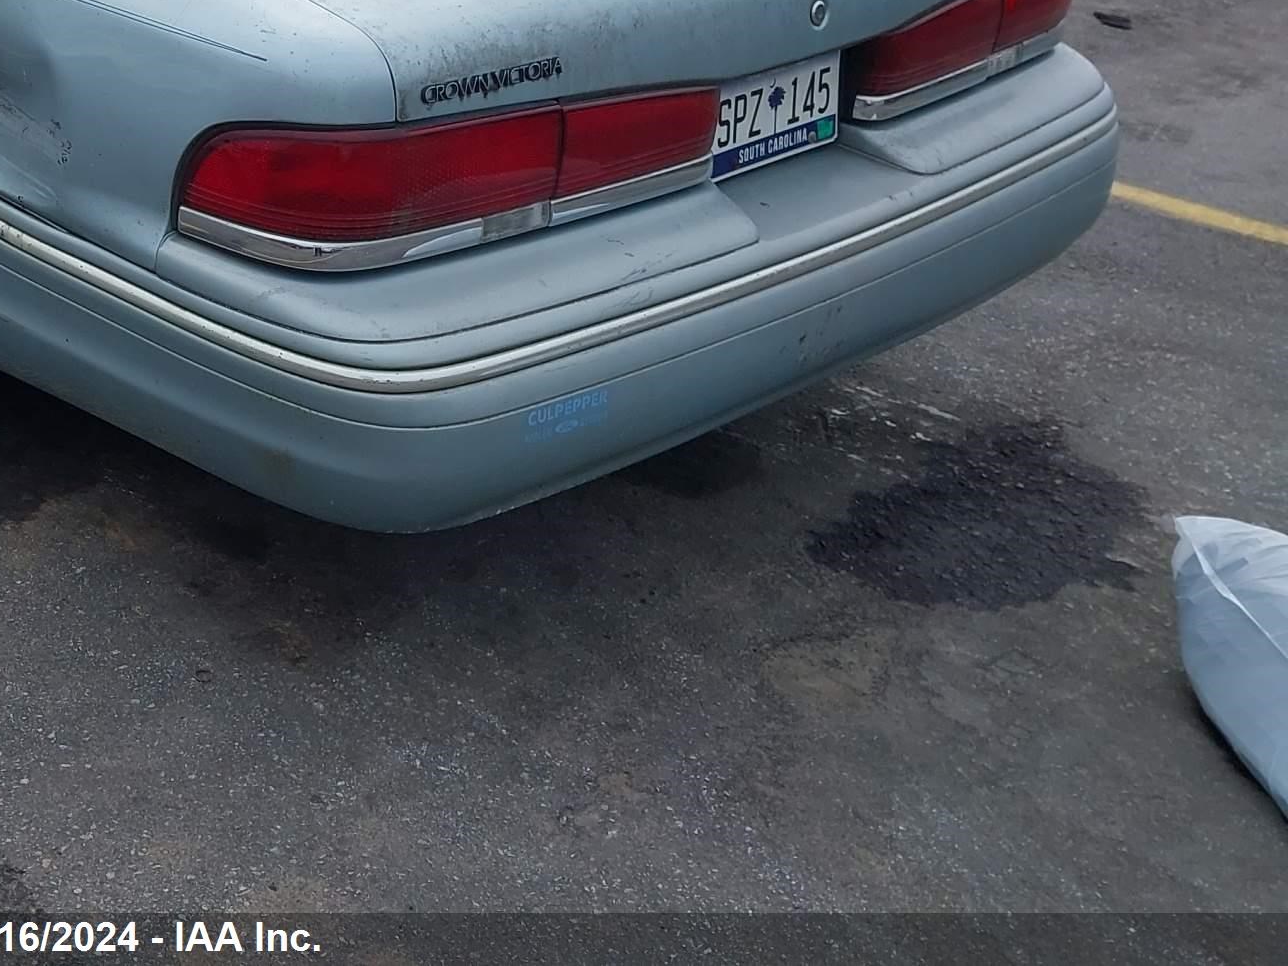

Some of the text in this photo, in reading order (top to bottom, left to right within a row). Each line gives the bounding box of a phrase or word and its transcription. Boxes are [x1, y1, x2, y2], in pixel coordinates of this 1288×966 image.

[421, 56, 563, 104] CROWN VICTORIA
[718, 66, 831, 148] SPZ 145
[738, 127, 808, 164] SOUTH CAROLINA
[527, 390, 609, 427] CULPEPPER
